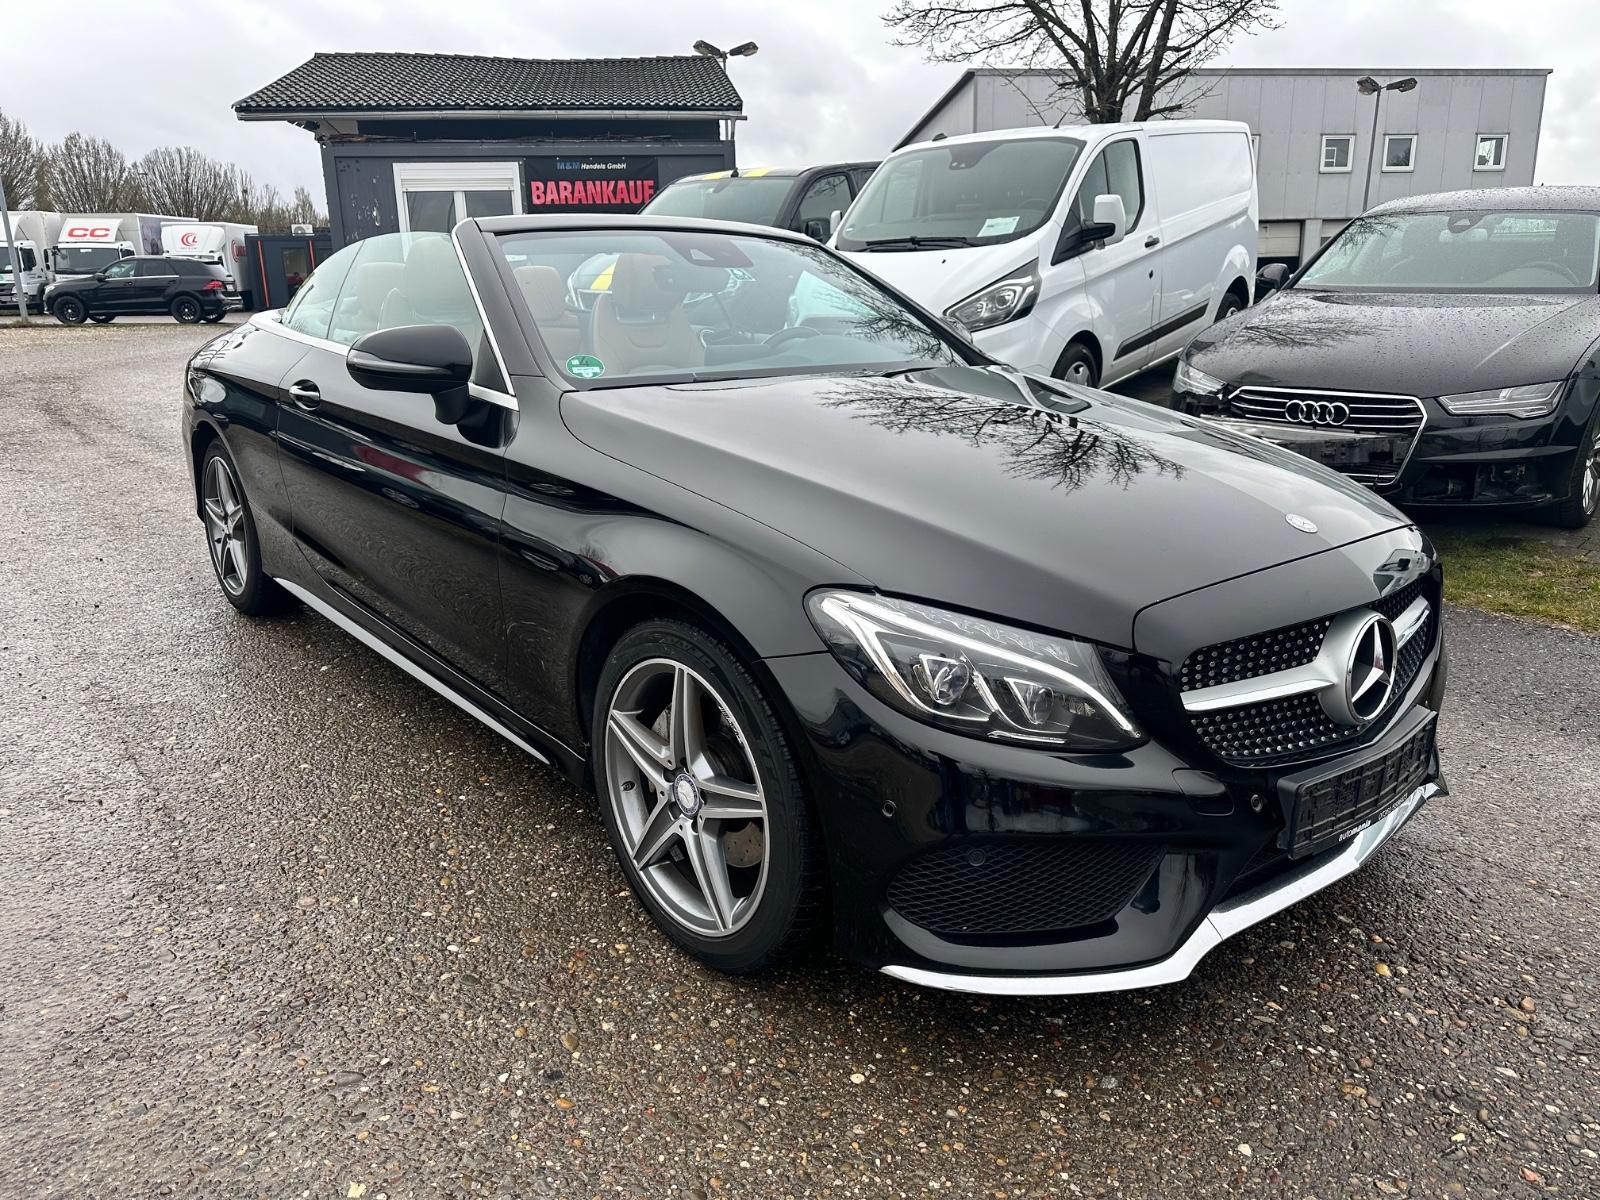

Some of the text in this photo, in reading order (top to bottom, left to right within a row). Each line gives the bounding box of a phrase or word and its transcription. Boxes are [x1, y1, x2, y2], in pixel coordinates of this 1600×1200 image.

[581, 162, 606, 170] Handels
[607, 162, 627, 170] GmbH
[531, 179, 655, 205] BARANKAUF
[67, 227, 111, 238] CC
